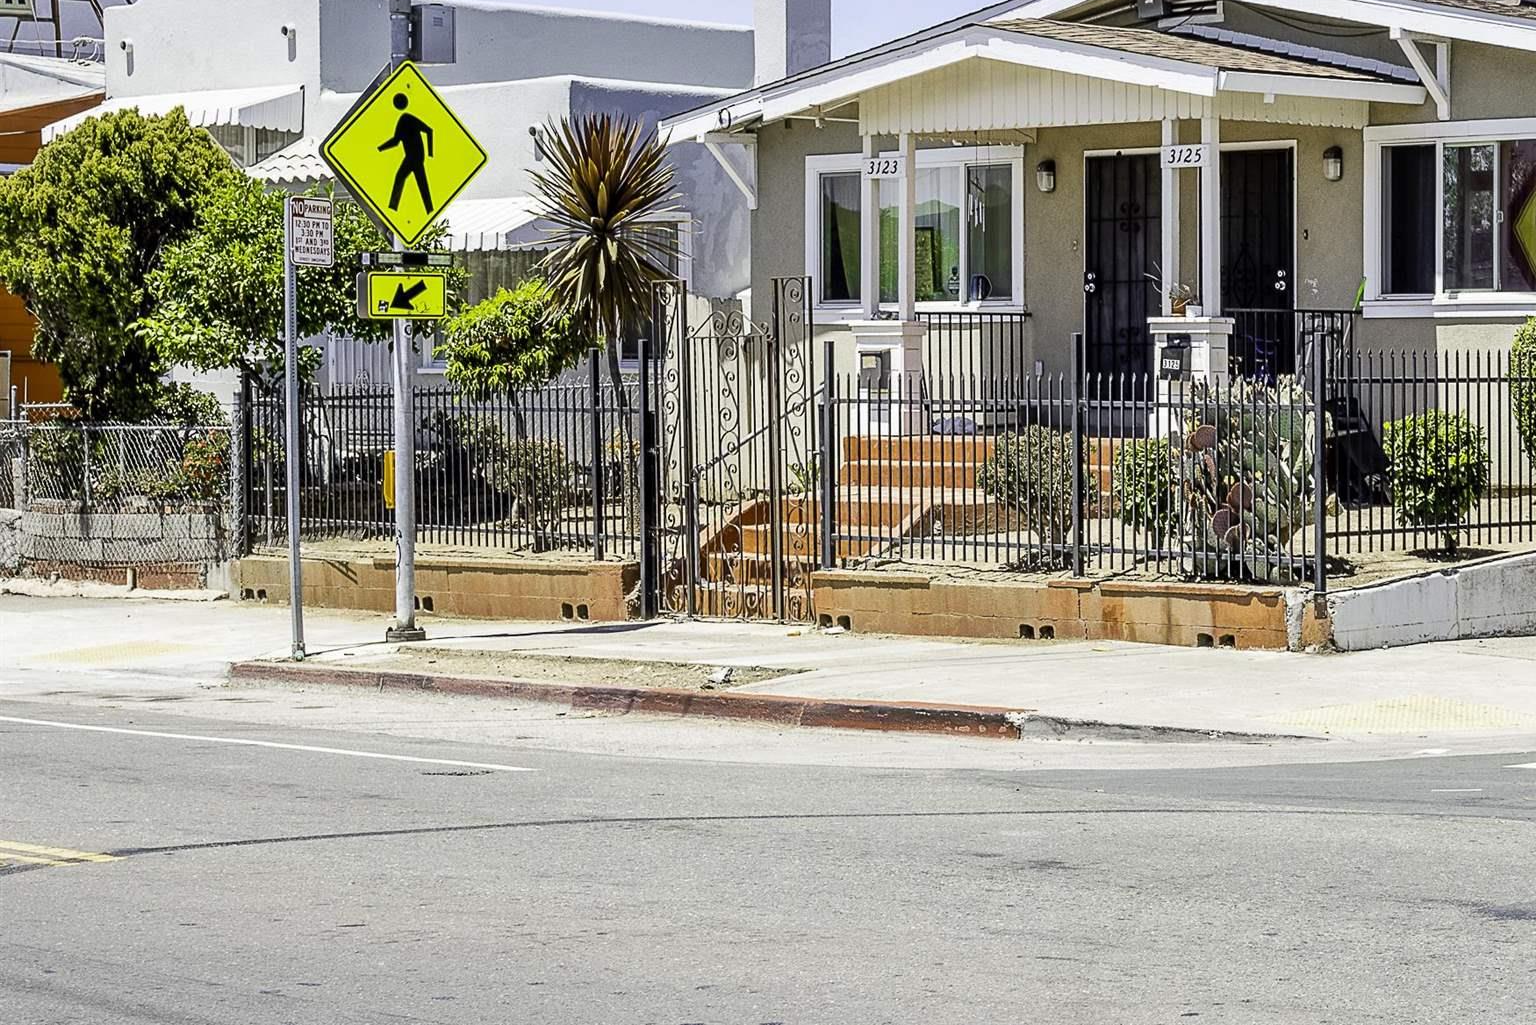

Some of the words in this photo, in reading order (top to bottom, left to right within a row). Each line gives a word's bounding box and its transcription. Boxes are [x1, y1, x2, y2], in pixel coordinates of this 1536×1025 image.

[1168, 148, 1202, 164] 3125
[867, 160, 898, 174] 3123
[293, 201, 304, 215] NO
[304, 204, 330, 215] PARKING
[312, 221, 320, 229] PM
[321, 221, 329, 230] TO
[316, 229, 323, 238] PM
[305, 237, 317, 246] AND
[295, 246, 330, 256] WEDNESDAYS
